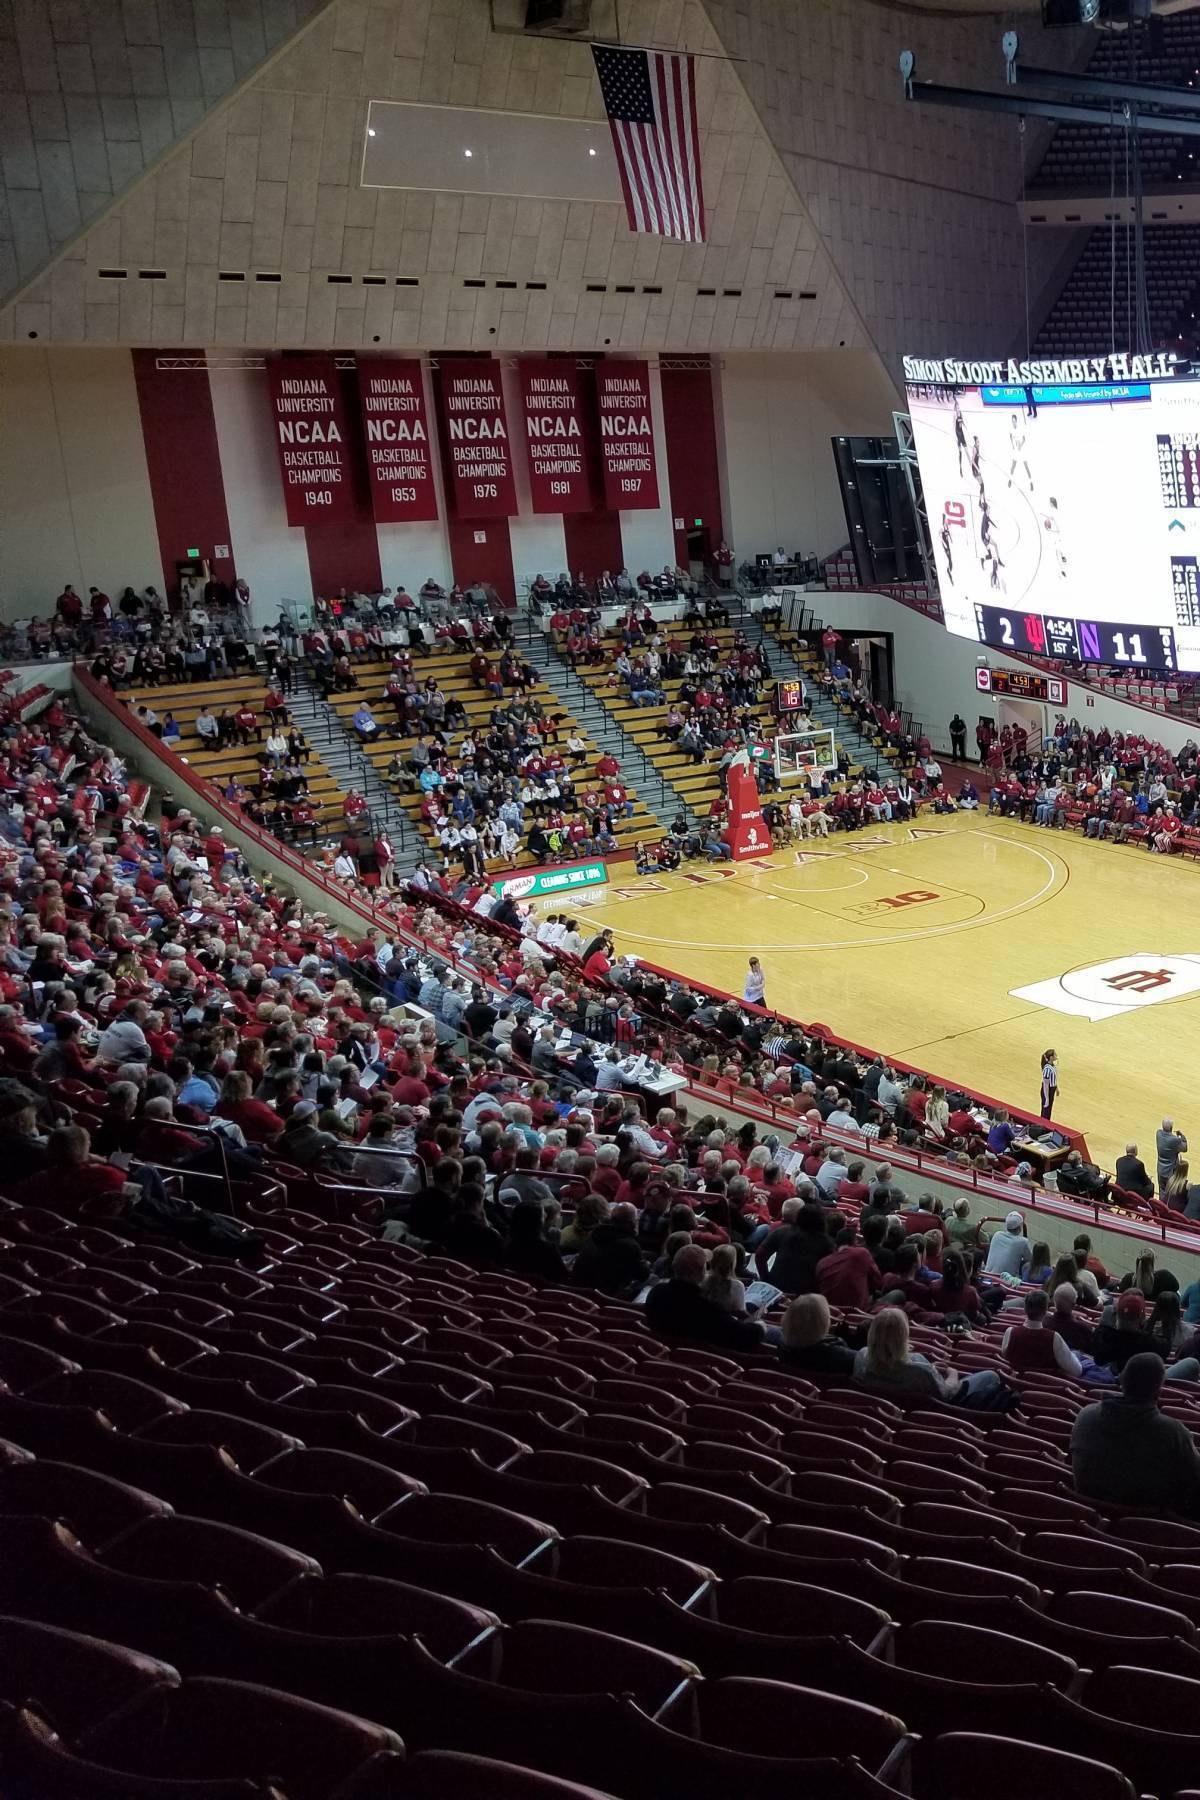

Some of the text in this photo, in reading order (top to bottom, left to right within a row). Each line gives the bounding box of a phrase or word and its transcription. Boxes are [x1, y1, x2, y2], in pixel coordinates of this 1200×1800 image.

[902, 352, 1176, 384] SIMON SKJODT ASSEMBLY HALL
[281, 379, 327, 394] INDIANA
[370, 379, 413, 393] INDIANA
[453, 379, 494, 393] INDIANA
[530, 378, 569, 392] INDIANA
[605, 378, 641, 392] INDIANA
[276, 398, 334, 412] UNIVERSITY
[365, 397, 420, 411] UNIVERSITY
[448, 396, 501, 410] UNIVERSITY
[525, 395, 576, 409] UNIVERSITY
[600, 395, 647, 409] UNIVERSITY
[278, 420, 342, 443] NCAA
[367, 419, 426, 441] NCAA
[449, 418, 507, 440] NCAA
[526, 416, 581, 437] NCAA
[600, 415, 651, 436] NCAA
[371, 449, 427, 463] BASKETBALL
[453, 446, 507, 461] BASKETBALL
[530, 443, 582, 458] BASKETBALL
[604, 442, 651, 456] BASKETBALL
[283, 451, 342, 466] BASKETBALL
[608, 458, 651, 472] CHAMPIONS
[376, 466, 426, 481] CHAMPIONS
[458, 463, 507, 478] CHAMPIONS
[534, 460, 581, 474] CHAMPIONS
[288, 468, 342, 484] CHAMPIONS
[473, 484, 497, 498] 1976
[550, 481, 570, 494] 1981
[621, 478, 642, 492] 1987
[305, 491, 332, 506] 1940
[391, 487, 417, 502] 1953
[999, 617, 1015, 645] 2
[1046, 619, 1073, 637] 4:54
[1080, 622, 1100, 659] N
[1112, 632, 1147, 662] 11
[1052, 642, 1068, 654] 1ST
[784, 682, 800, 692] 4:53
[787, 691, 798, 705] 16
[741, 810, 760, 820] meijer
[739, 842, 769, 853] Smithville
[541, 875, 569, 888] CLEANING
[568, 871, 585, 884] SINCE
